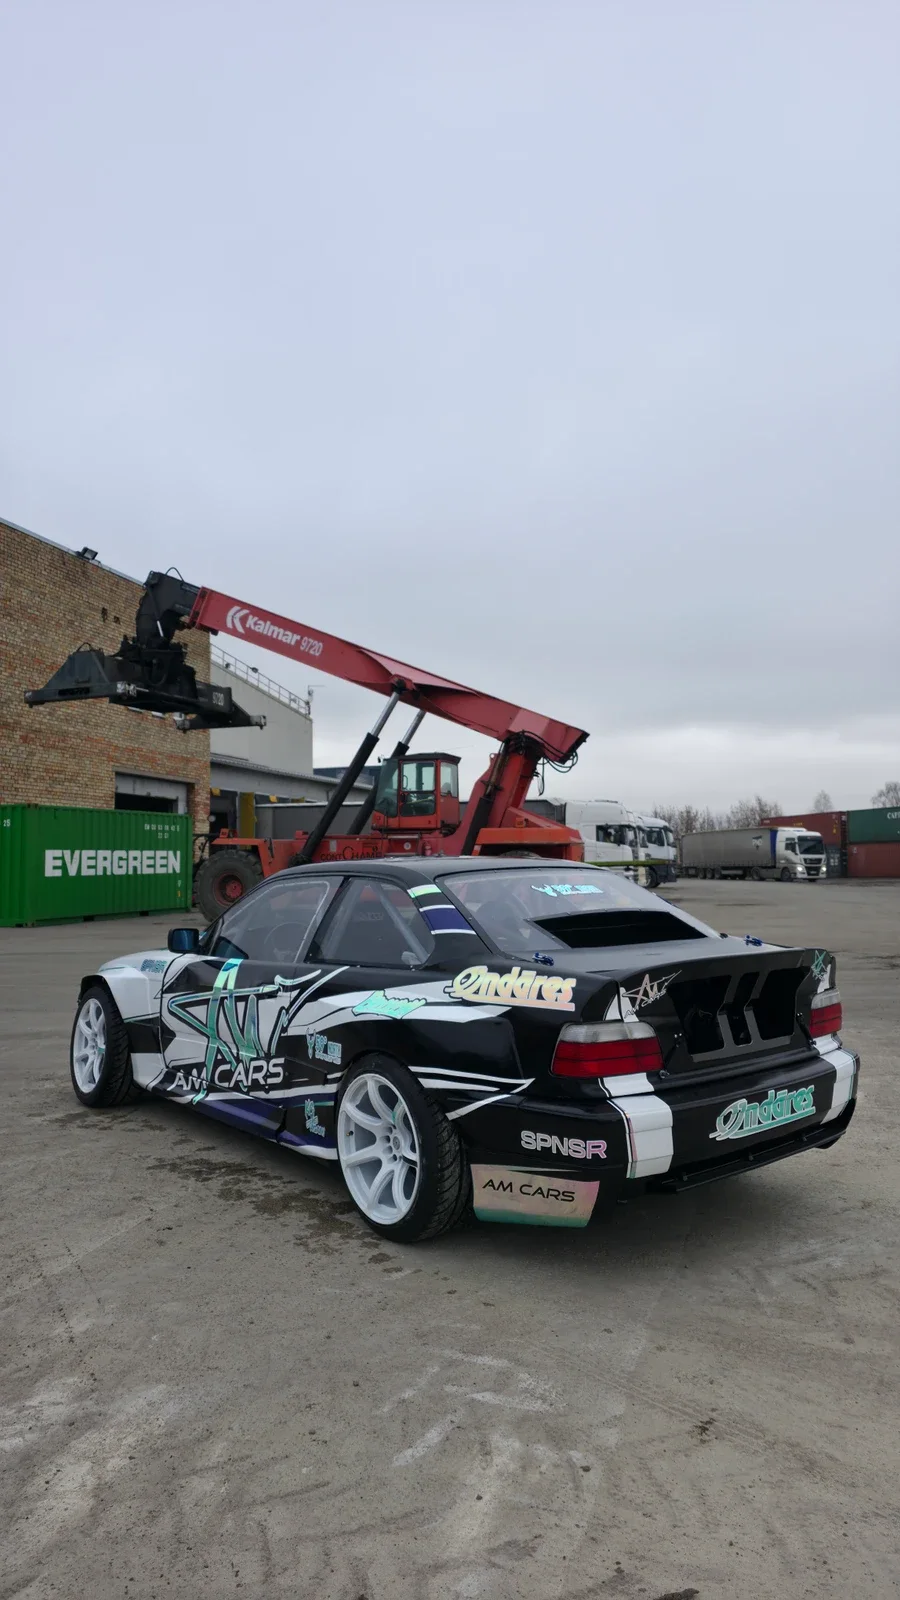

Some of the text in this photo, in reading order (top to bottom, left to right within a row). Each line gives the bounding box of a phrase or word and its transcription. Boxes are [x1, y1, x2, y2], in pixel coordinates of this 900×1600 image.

[245, 614, 301, 646] Kalmar
[300, 636, 323, 656] 9720
[44, 849, 181, 877] EVERGREEN
[214, 1057, 285, 1088] CARS
[520, 1130, 608, 1160] SPNSR
[482, 1179, 575, 1202] AM CARS
